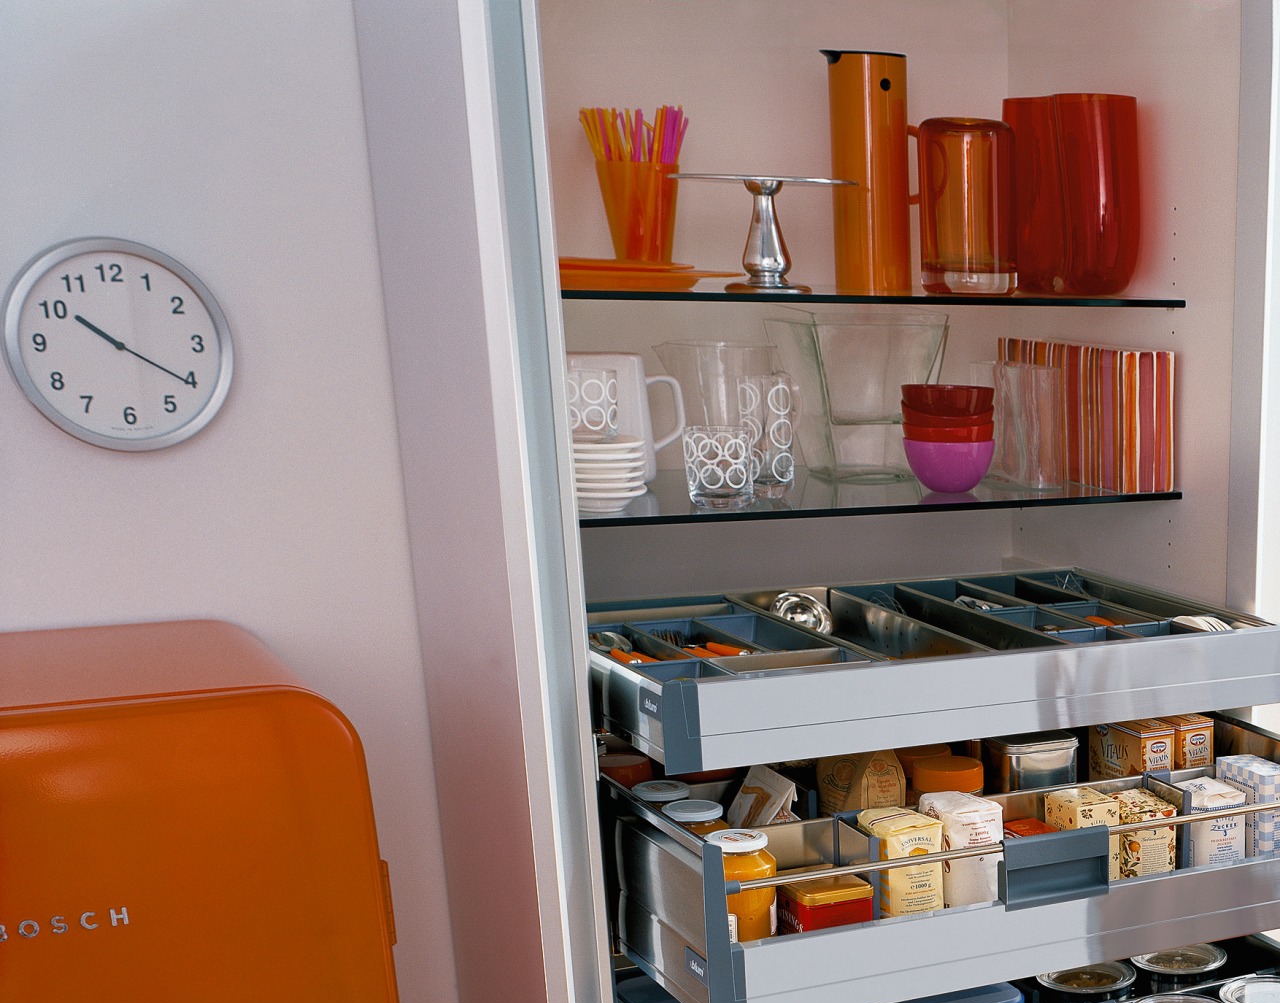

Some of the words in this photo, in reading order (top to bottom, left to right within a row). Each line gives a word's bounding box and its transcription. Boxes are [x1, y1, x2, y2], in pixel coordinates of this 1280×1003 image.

[95, 263, 124, 283] 12
[140, 273, 151, 292] 1
[61, 274, 85, 293] 11
[39, 299, 67, 320] 10
[170, 296, 185, 315] 2
[32, 333, 47, 353] 9
[190, 334, 205, 353] 3
[50, 371, 65, 391] 8
[184, 371, 197, 389] 4
[79, 395, 93, 414] 7
[164, 395, 177, 414] 5
[123, 406, 137, 425] 6
